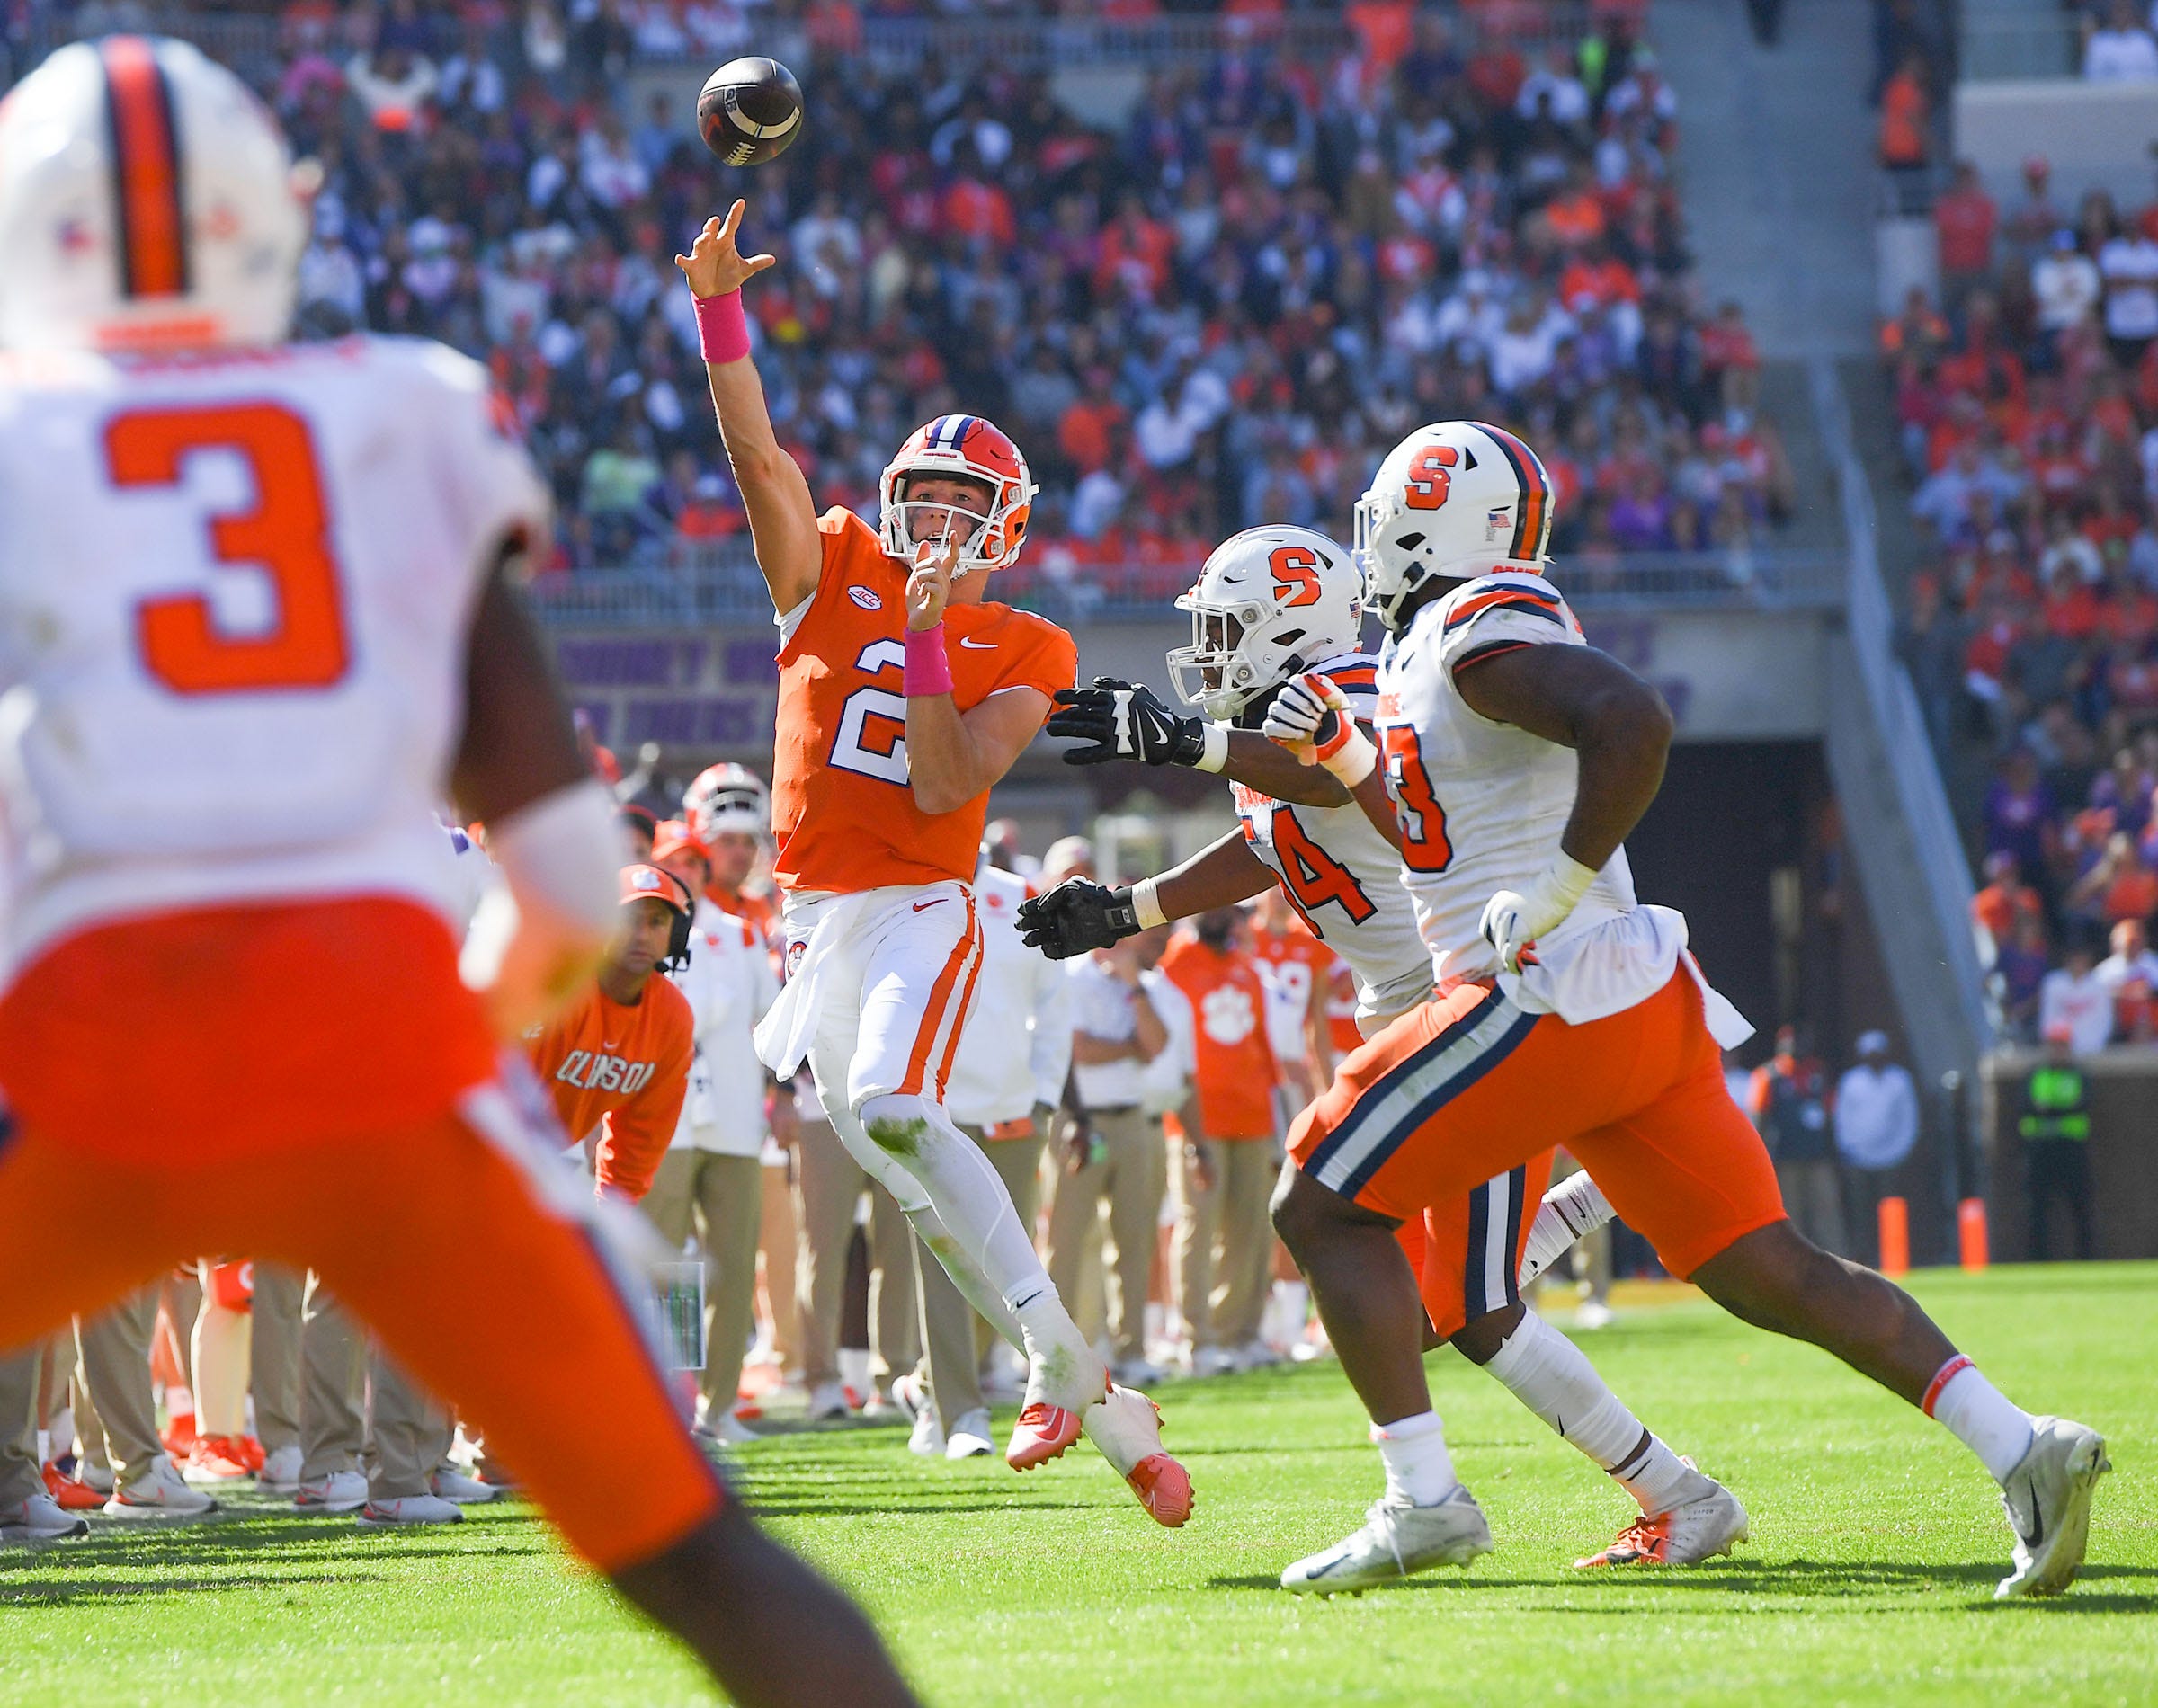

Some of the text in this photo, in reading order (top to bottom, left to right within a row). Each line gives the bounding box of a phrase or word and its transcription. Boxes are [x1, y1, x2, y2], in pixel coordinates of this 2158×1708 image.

[1404, 446, 1459, 511] S
[102, 399, 352, 694] 3
[1268, 547, 1322, 608] S
[852, 590, 879, 607] ACC
[827, 636, 910, 788] 2
